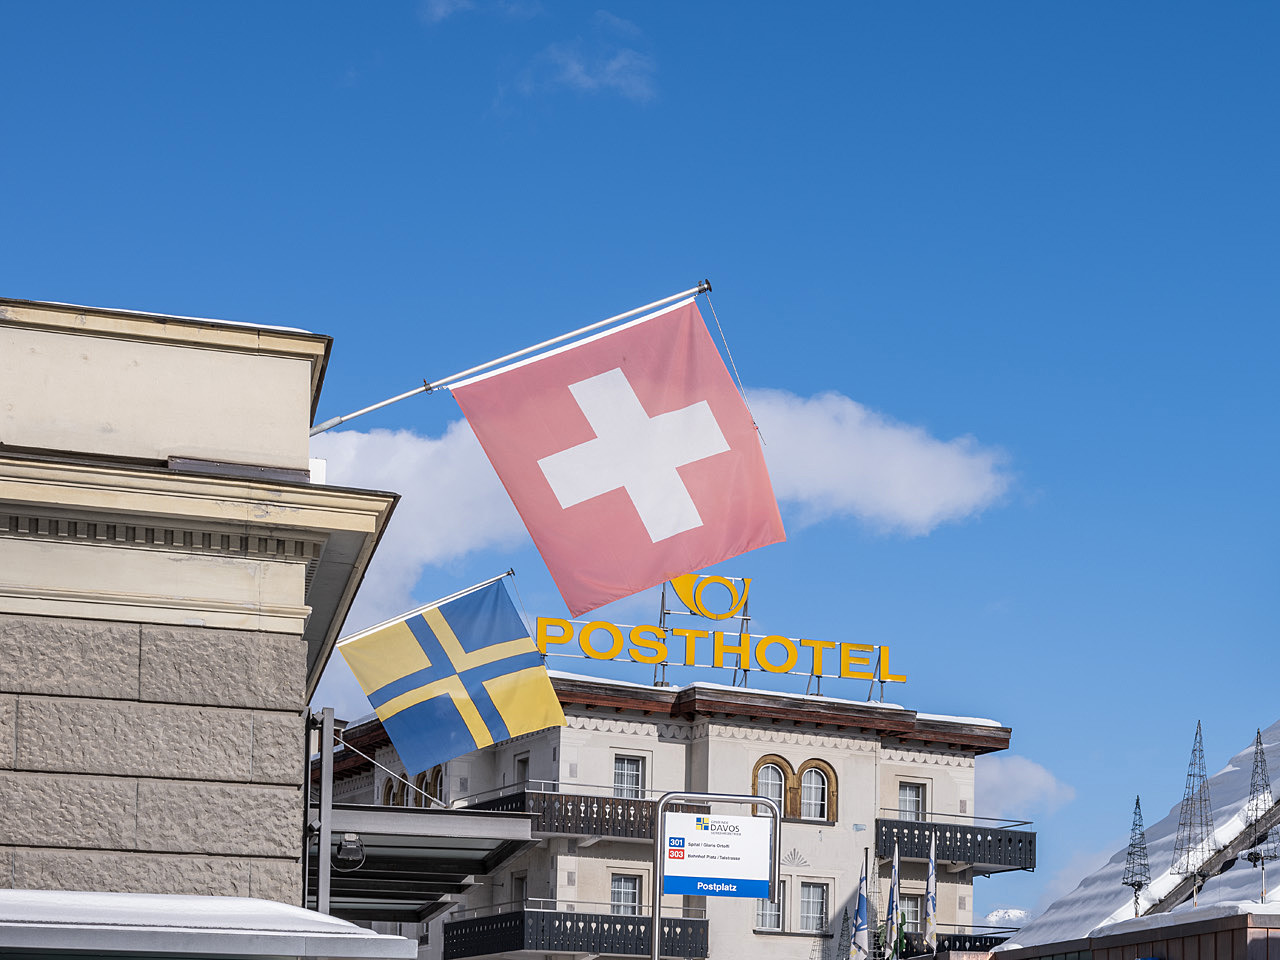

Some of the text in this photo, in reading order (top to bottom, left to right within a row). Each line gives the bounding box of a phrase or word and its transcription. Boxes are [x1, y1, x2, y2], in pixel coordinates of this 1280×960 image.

[537, 617, 907, 683] POSTHOTEL
[710, 824, 740, 832] DAVOS
[697, 882, 738, 893] Postplatz
